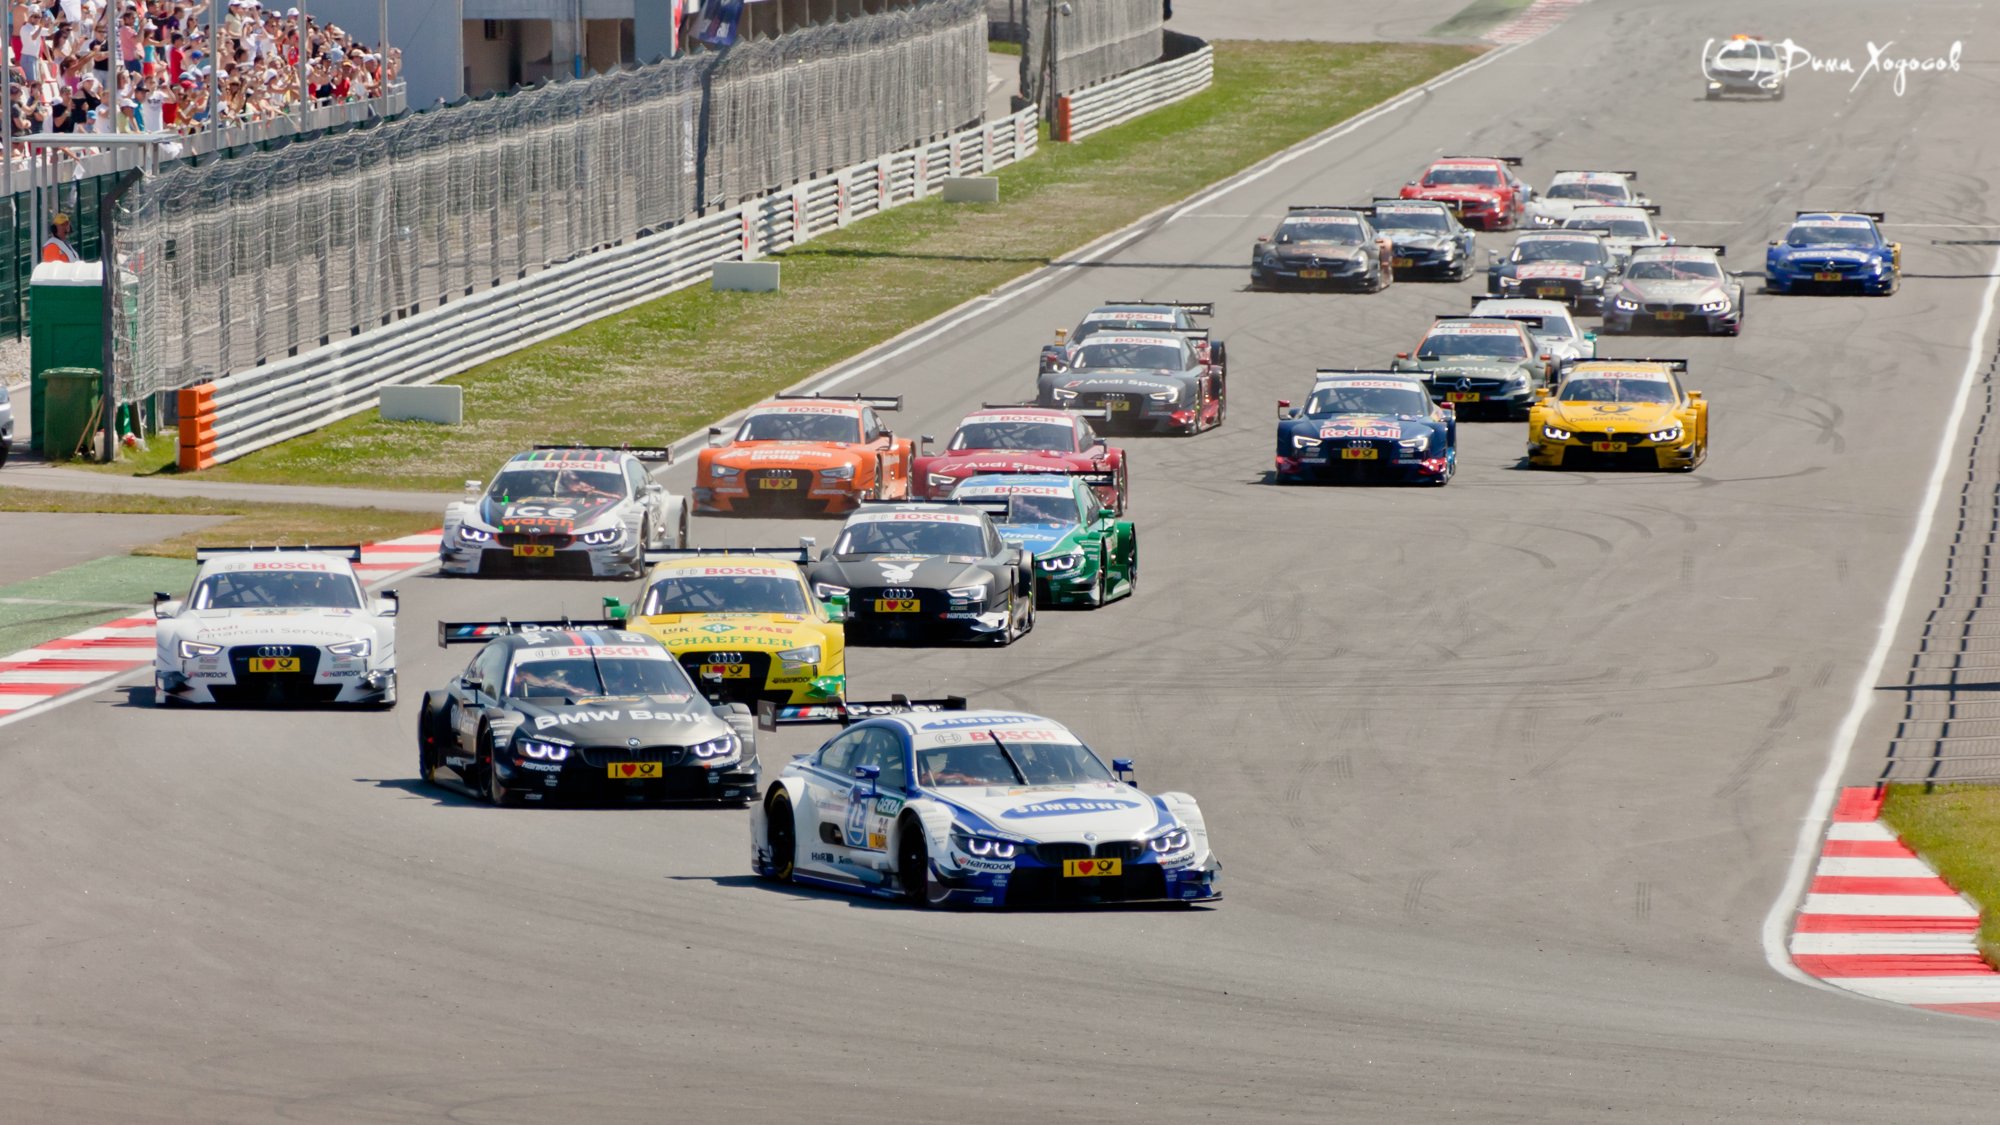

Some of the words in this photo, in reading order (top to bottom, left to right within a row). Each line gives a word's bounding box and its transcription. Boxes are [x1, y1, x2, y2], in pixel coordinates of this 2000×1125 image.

[1321, 428, 1359, 438] Red
[1362, 428, 1401, 438] Bull
[751, 449, 833, 458] Hoffmann
[544, 461, 606, 470] BOSCH
[994, 486, 1058, 494] BOSCH
[502, 517, 575, 526] watch
[894, 513, 960, 521] BOSCH
[253, 562, 326, 570] BOSCH
[704, 567, 777, 575] BOSCH
[196, 628, 275, 640] Financial
[280, 627, 353, 639] Services
[198, 625, 239, 633] Audi
[658, 635, 793, 648] SCHAEFFLER
[567, 646, 650, 656] BOSCH
[534, 710, 620, 730] BMW
[628, 710, 711, 725] Bank
[935, 716, 1034, 726] SAMSUNG
[969, 730, 1057, 742] BOSCH
[1015, 802, 1129, 813] SAMSUNG
